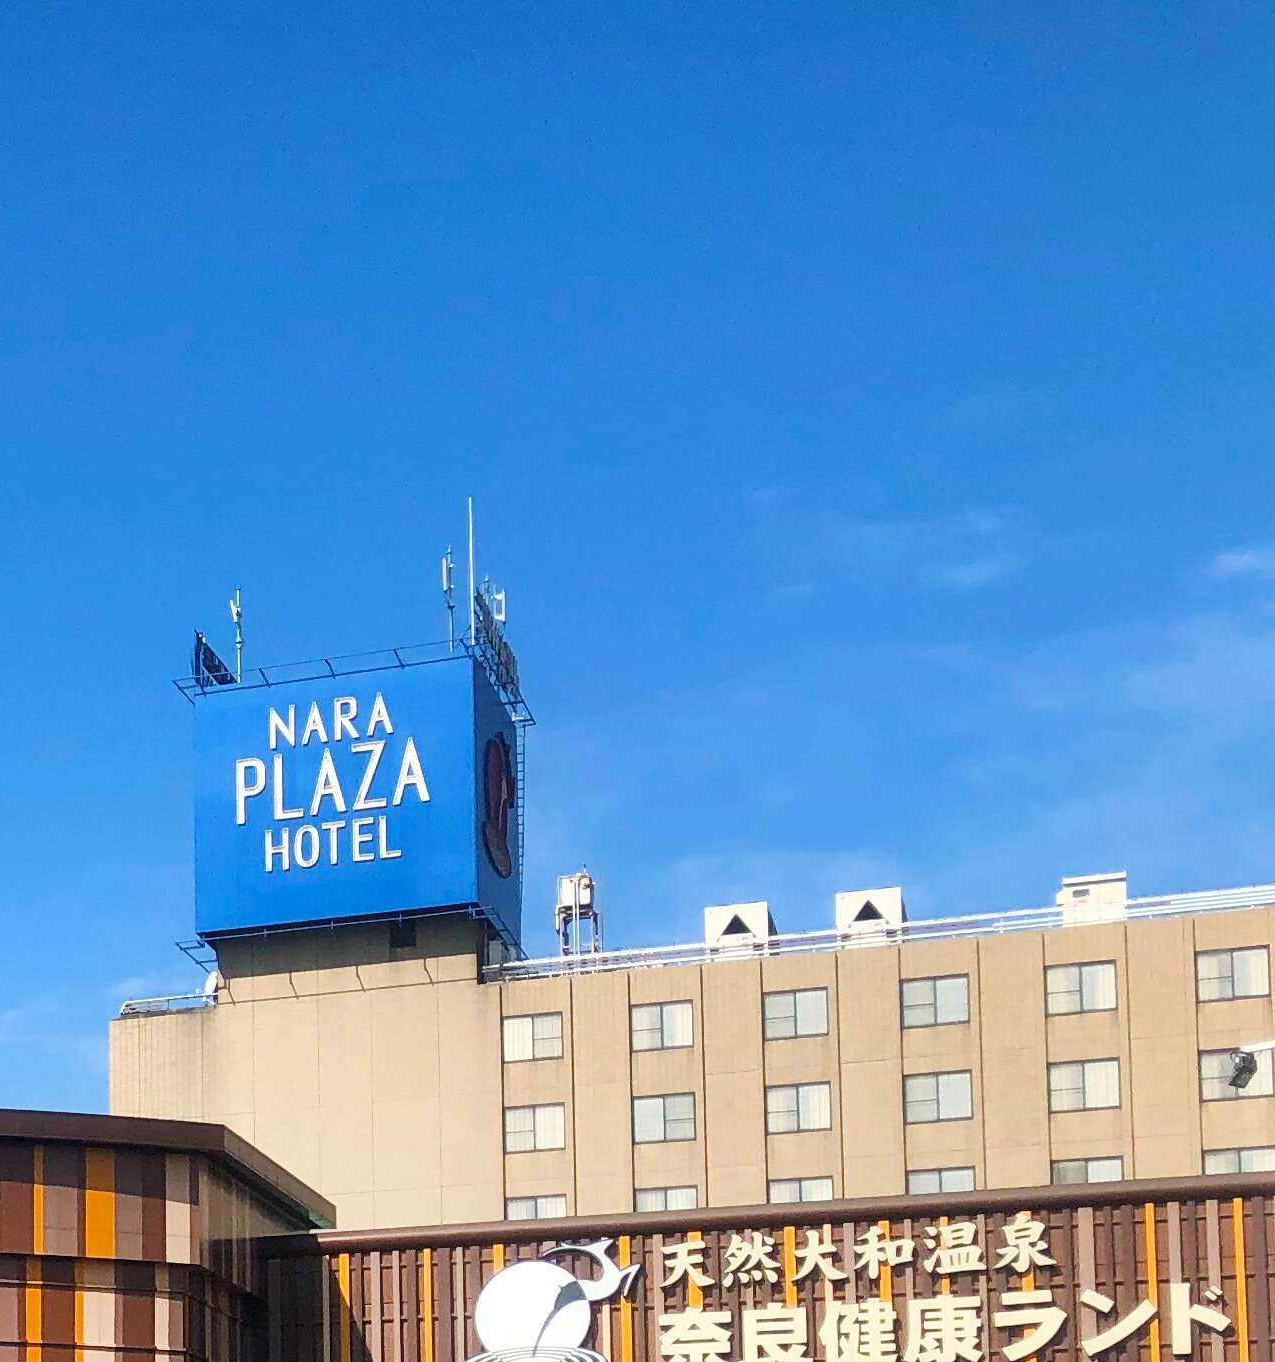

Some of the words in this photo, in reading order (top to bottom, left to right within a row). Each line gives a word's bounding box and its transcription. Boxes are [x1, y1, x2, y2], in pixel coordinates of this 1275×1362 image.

[269, 692, 394, 749] NARA
[235, 736, 431, 825] PLAZA
[265, 815, 402, 872] HOTEL
[660, 1215, 1058, 1288] 天然大和温泉
